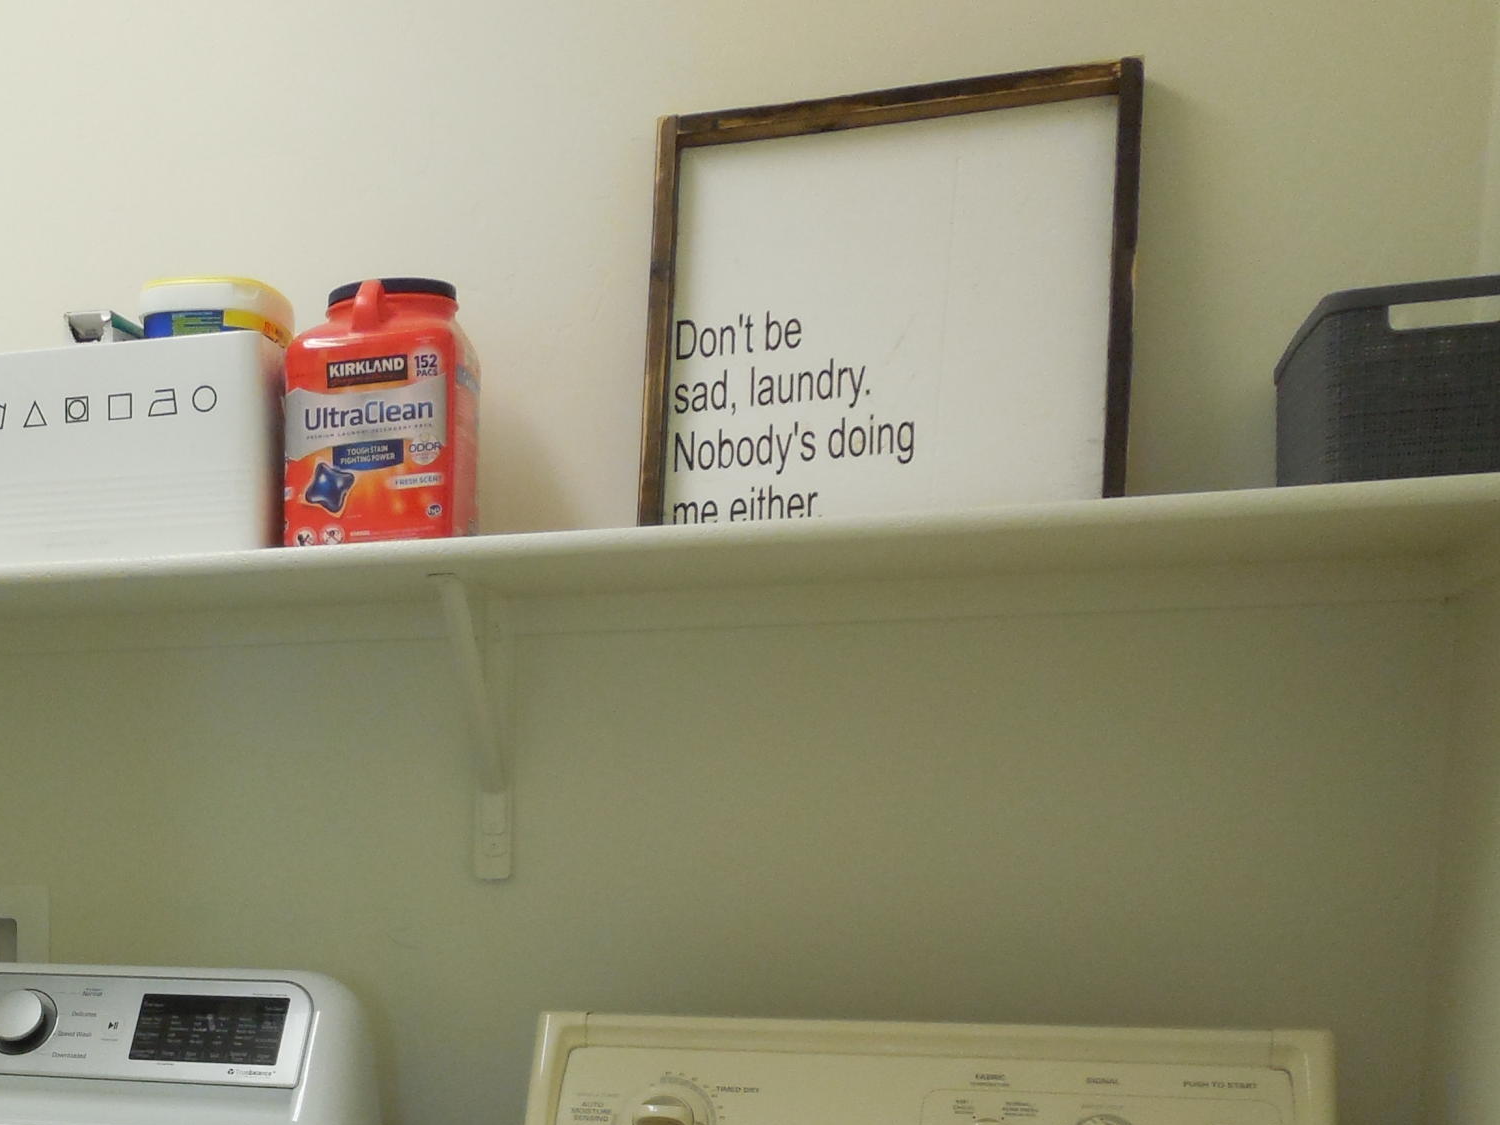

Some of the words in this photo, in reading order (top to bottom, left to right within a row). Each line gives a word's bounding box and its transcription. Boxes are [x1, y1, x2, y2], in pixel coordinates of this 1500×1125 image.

[675, 313, 754, 361] Don't
[765, 310, 802, 351] be
[328, 357, 405, 378] KIRKLAND
[413, 354, 438, 369] 152
[416, 368, 438, 377] PACS
[673, 369, 737, 416] sad,
[750, 358, 871, 409] laundry.
[304, 400, 434, 431] UltraClean
[347, 446, 370, 456] TOUGH
[370, 444, 389, 454] STAIN
[408, 441, 442, 453] ODOR
[673, 421, 817, 476] Nobody's
[828, 414, 915, 465] doing
[340, 455, 372, 465] FIGHTING
[372, 452, 396, 462] POWER
[395, 476, 418, 486] FRESH
[672, 500, 719, 526] me
